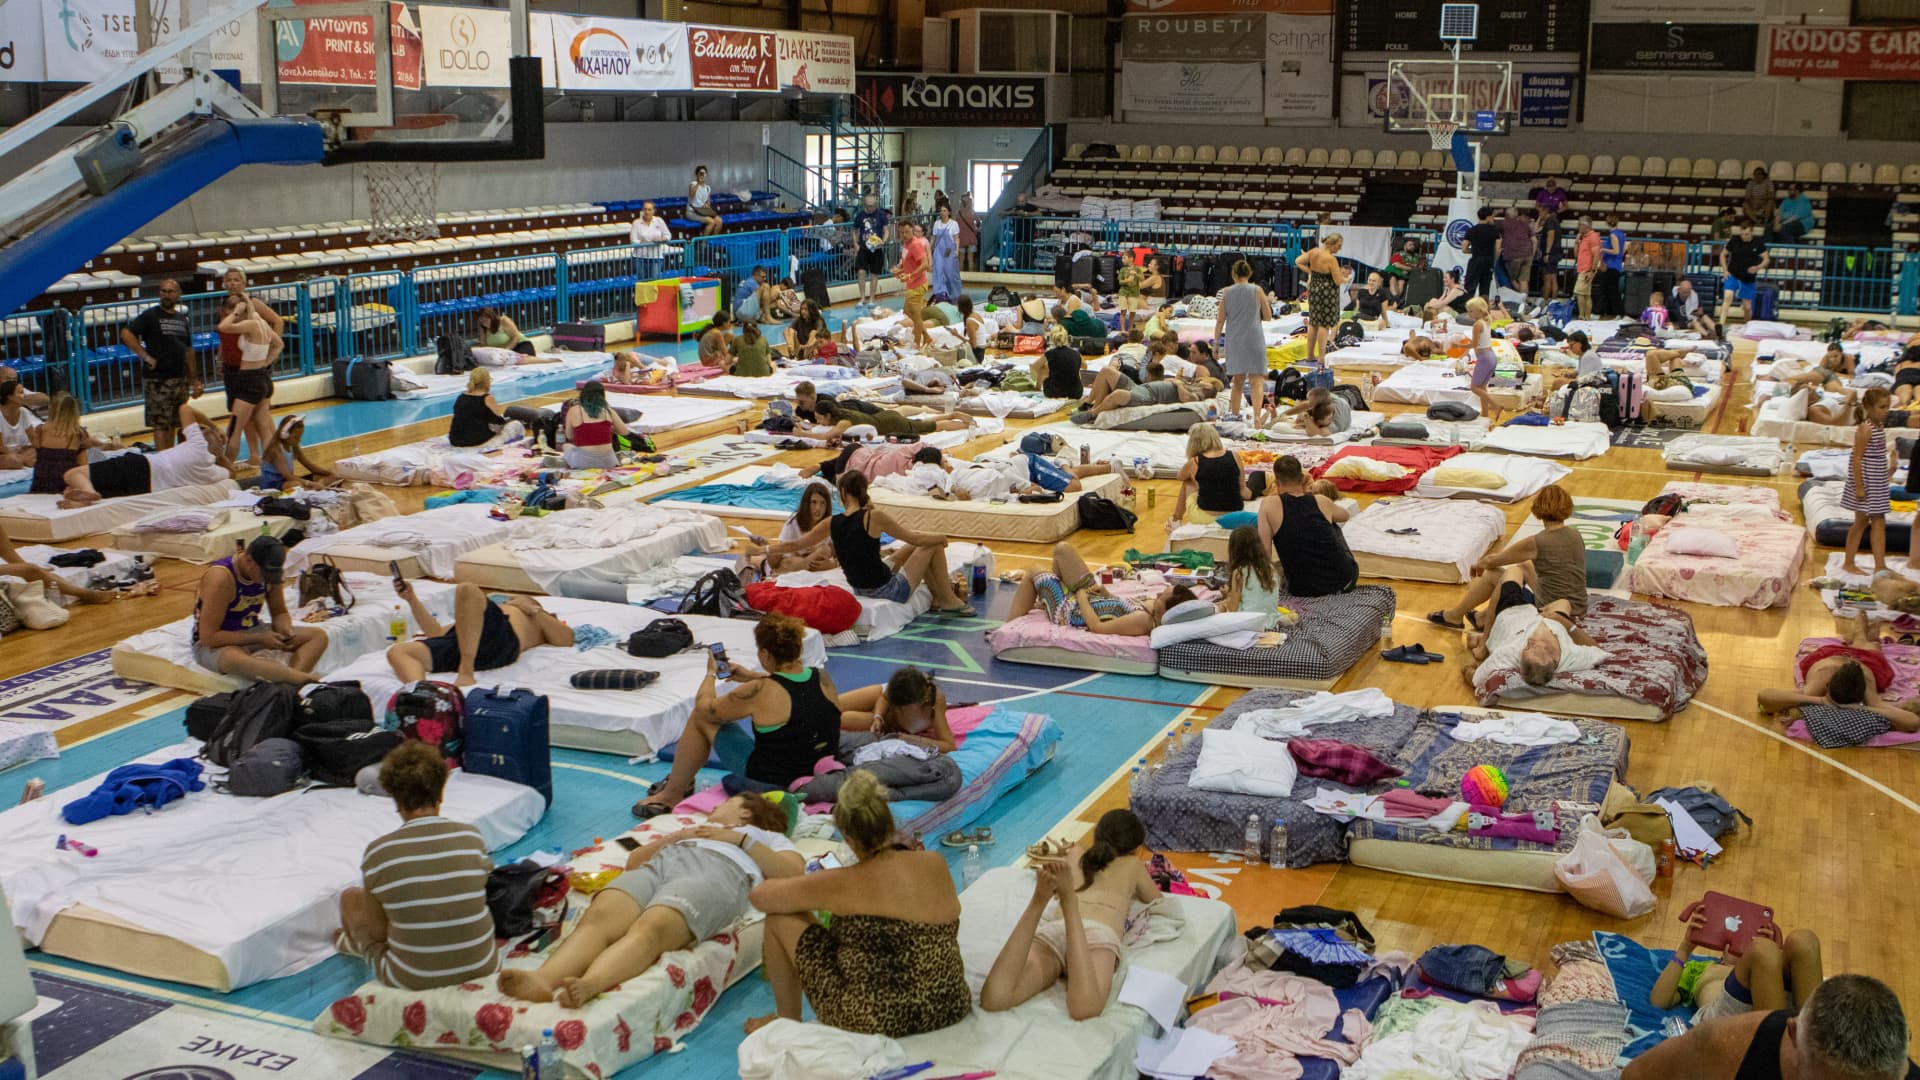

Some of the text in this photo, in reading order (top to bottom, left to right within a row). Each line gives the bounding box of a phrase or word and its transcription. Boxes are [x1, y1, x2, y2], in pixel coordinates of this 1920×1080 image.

[1138, 19, 1252, 33] ROUBETI
[325, 38, 353, 53] PRINT
[354, 40, 362, 54] &
[693, 30, 757, 60] Bailando
[778, 37, 821, 62] ΖΙΑΚΗΣ
[1509, 44, 1533, 52] FOULS
[1774, 29, 1862, 53] RODOS
[440, 49, 490, 70] IDOLO
[1635, 49, 1715, 60] semiramis
[1773, 57, 1840, 70] RENT A CAR
[574, 56, 631, 76] ΜΙΧΑΗΛΟΥ
[178, 1035, 298, 1071] ΕΣΑΚΕ
